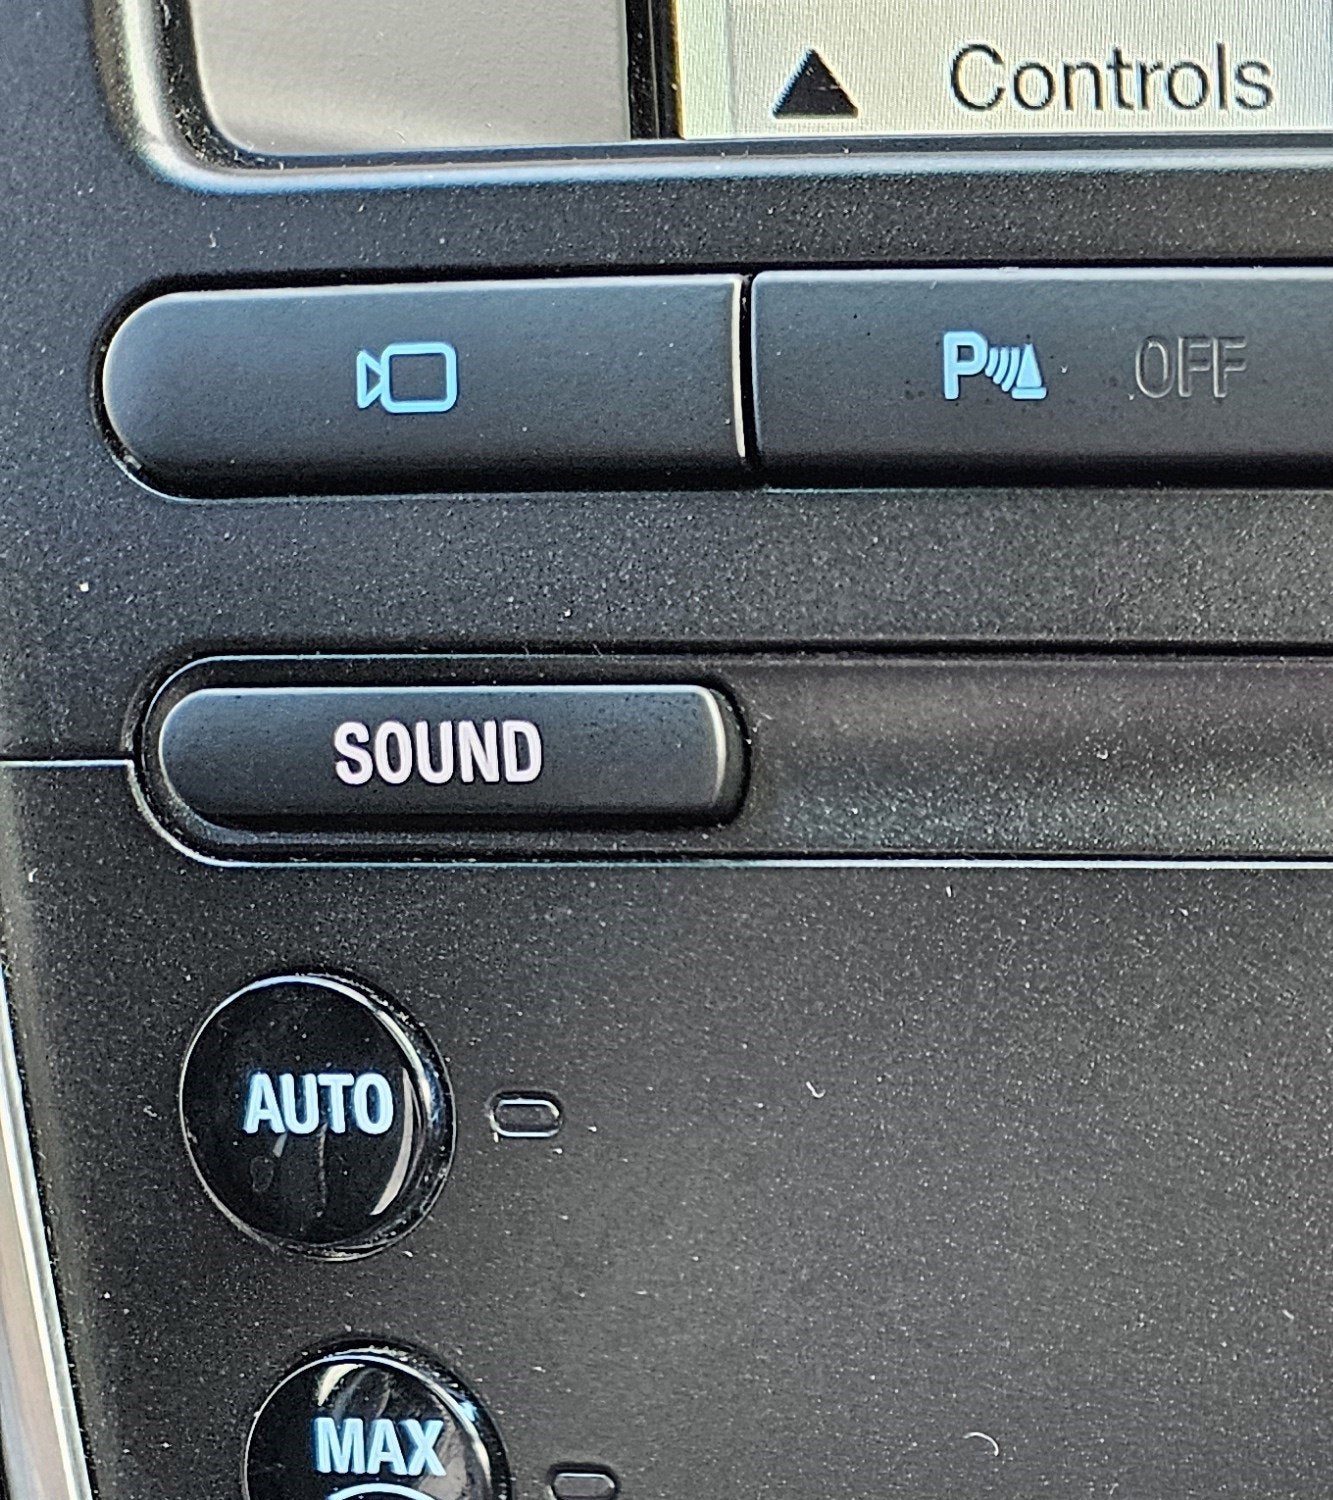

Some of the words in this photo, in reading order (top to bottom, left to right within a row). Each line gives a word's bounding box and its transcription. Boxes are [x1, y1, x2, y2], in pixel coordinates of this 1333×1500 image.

[949, 42, 1274, 112] Controls
[1134, 334, 1248, 399] OFF
[333, 719, 543, 785] SOUND
[242, 1072, 394, 1135] AUTO
[314, 1417, 446, 1477] MAX
